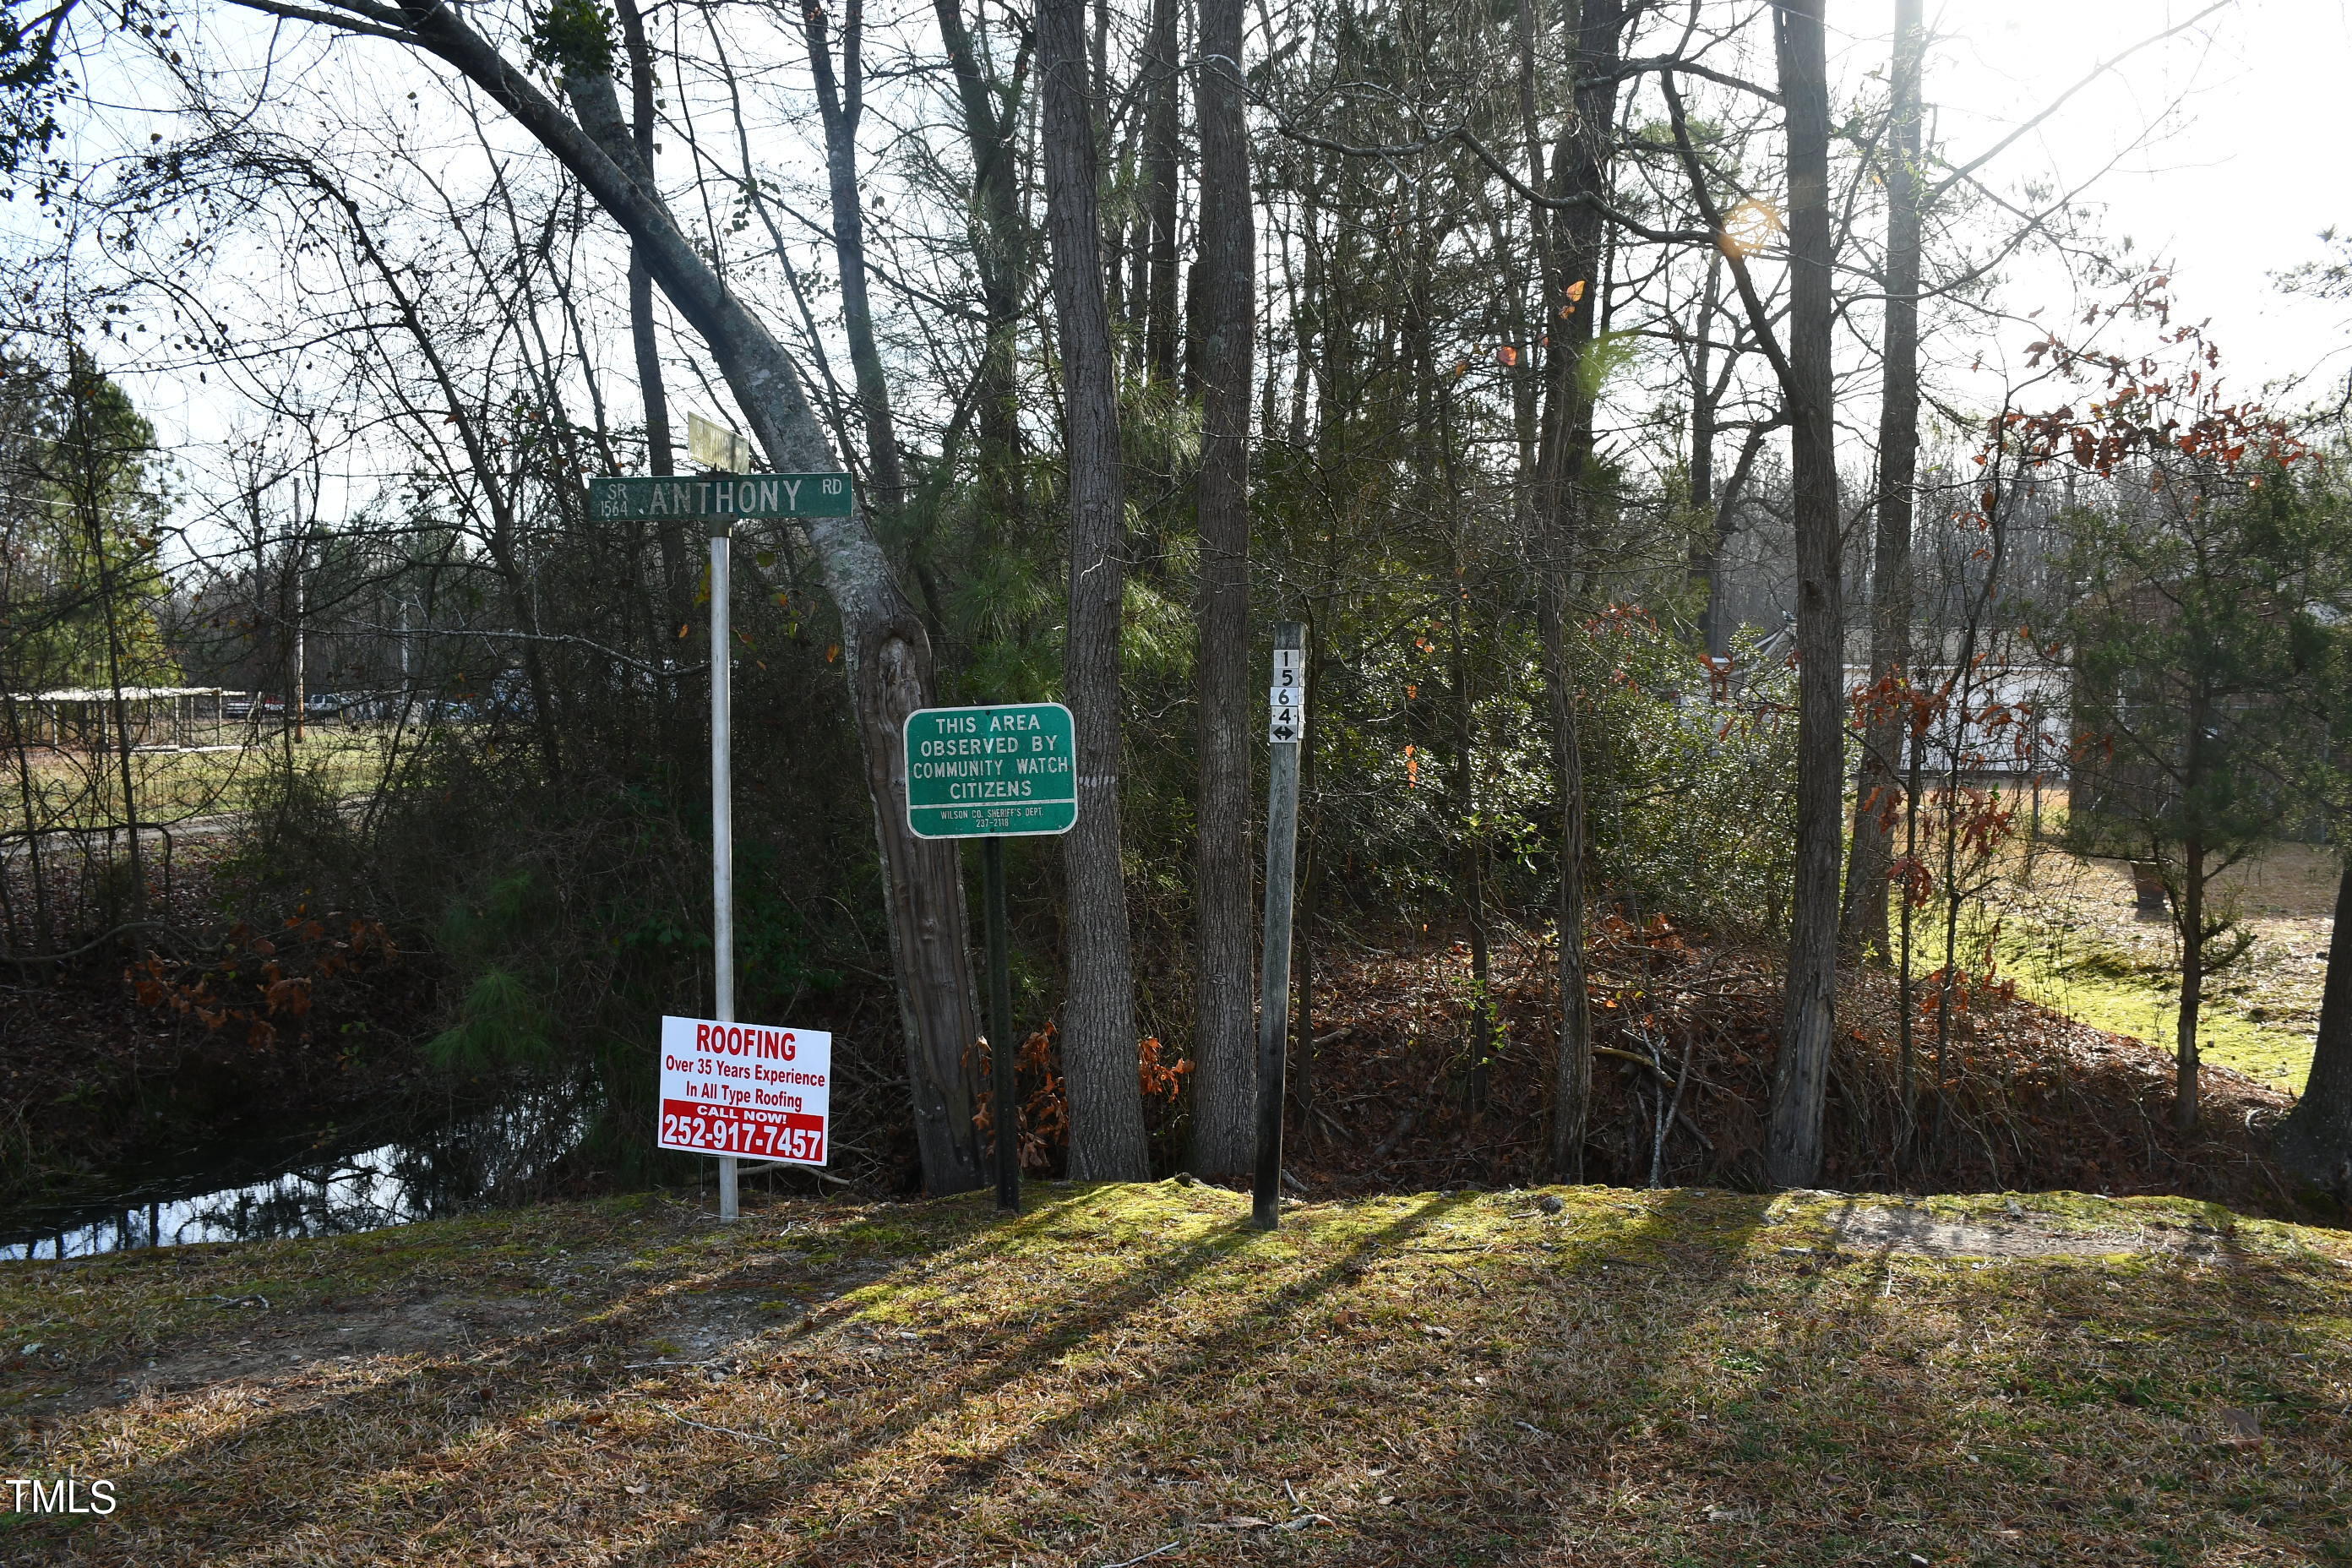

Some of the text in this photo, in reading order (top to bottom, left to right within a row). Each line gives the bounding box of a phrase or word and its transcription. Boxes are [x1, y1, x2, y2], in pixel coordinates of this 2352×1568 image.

[607, 482, 629, 500] SR
[649, 479, 843, 515] ANTHONY RD
[601, 500, 629, 518] 1564
[935, 714, 1041, 734] THIS AREA
[920, 734, 1059, 757] OBSERVED BY
[912, 756, 1068, 779] COMMUNITY WATCH
[950, 780, 1032, 799] CITIZENS
[940, 807, 1044, 819] WILSON CO. SHERIFF'S DEPT.
[976, 818, 1009, 828] 237-2118
[696, 1023, 796, 1062] ROOFING
[666, 1054, 825, 1087] Over 35 Years Experience
[686, 1081, 803, 1113] In All Type Roofing
[696, 1105, 787, 1124] CALL NOW!
[663, 1113, 822, 1159] 252-917-7457
